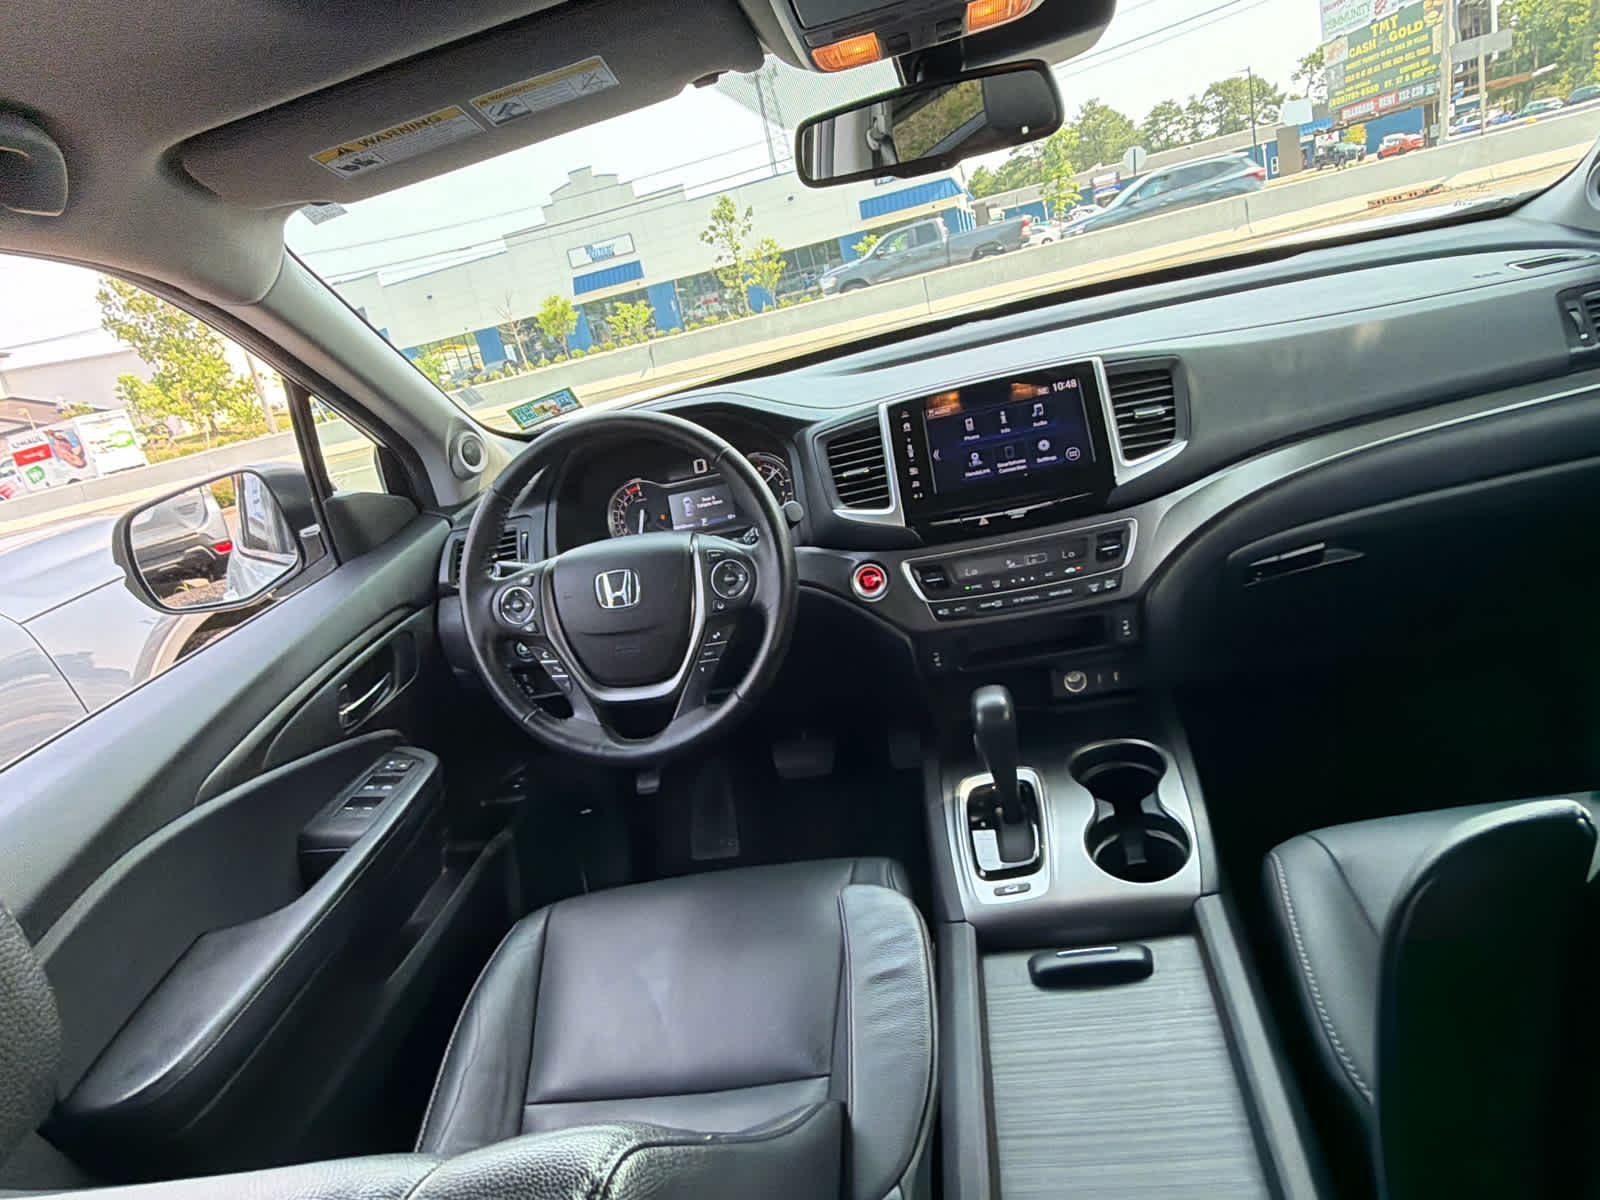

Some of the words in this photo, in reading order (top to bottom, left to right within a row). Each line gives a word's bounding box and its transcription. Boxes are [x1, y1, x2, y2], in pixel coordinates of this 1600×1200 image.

[1349, 39, 1377, 58] CASH
[1388, 20, 1424, 42] GOLD
[358, 116, 442, 146] WARNING
[1052, 379, 1077, 393] 10:48
